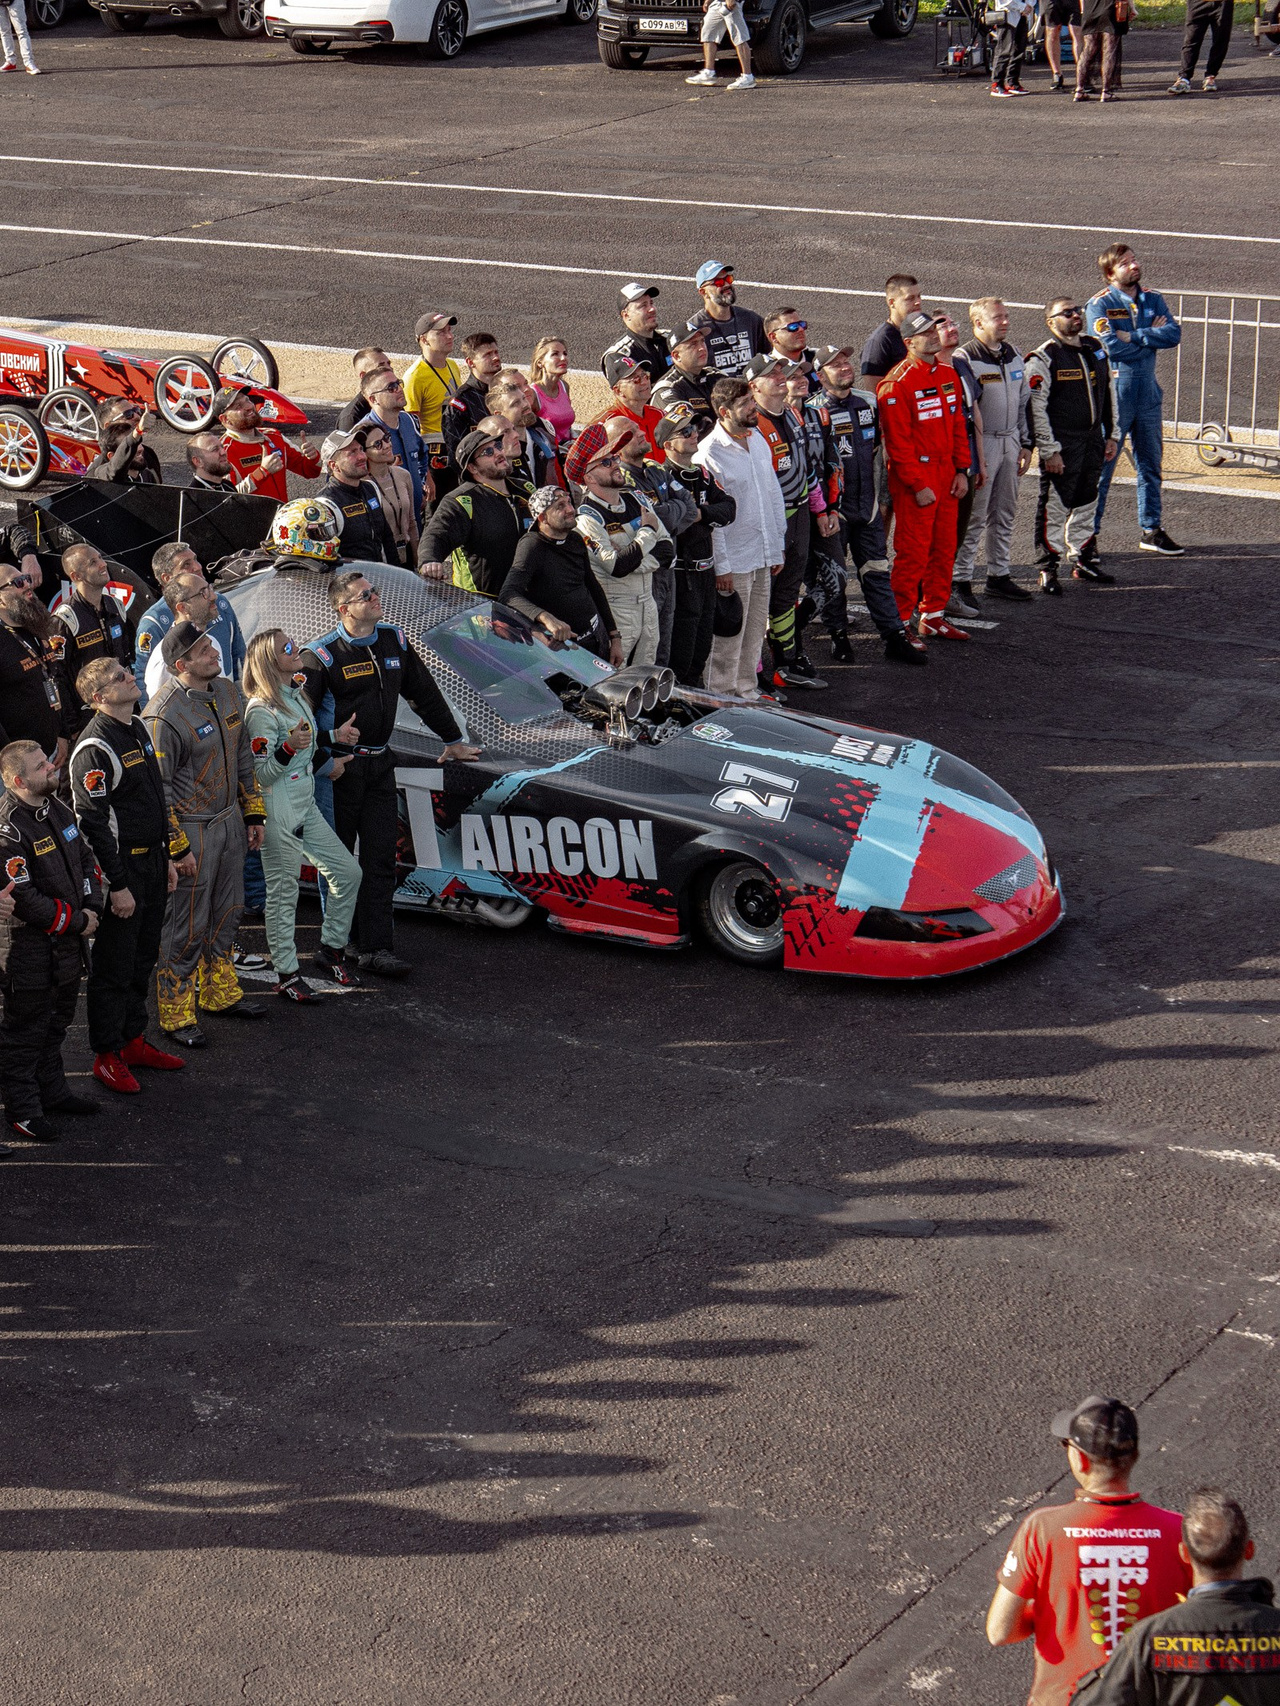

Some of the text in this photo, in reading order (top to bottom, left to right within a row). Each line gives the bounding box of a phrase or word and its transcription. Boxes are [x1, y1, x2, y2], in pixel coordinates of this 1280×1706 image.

[345, 663, 372, 676] RDRC
[710, 760, 799, 822] 27
[461, 813, 658, 881] AIRCON
[1063, 1527, 1162, 1539] ТЕХКОМИССИЯ
[1153, 1635, 1280, 1652] EXTRICATION
